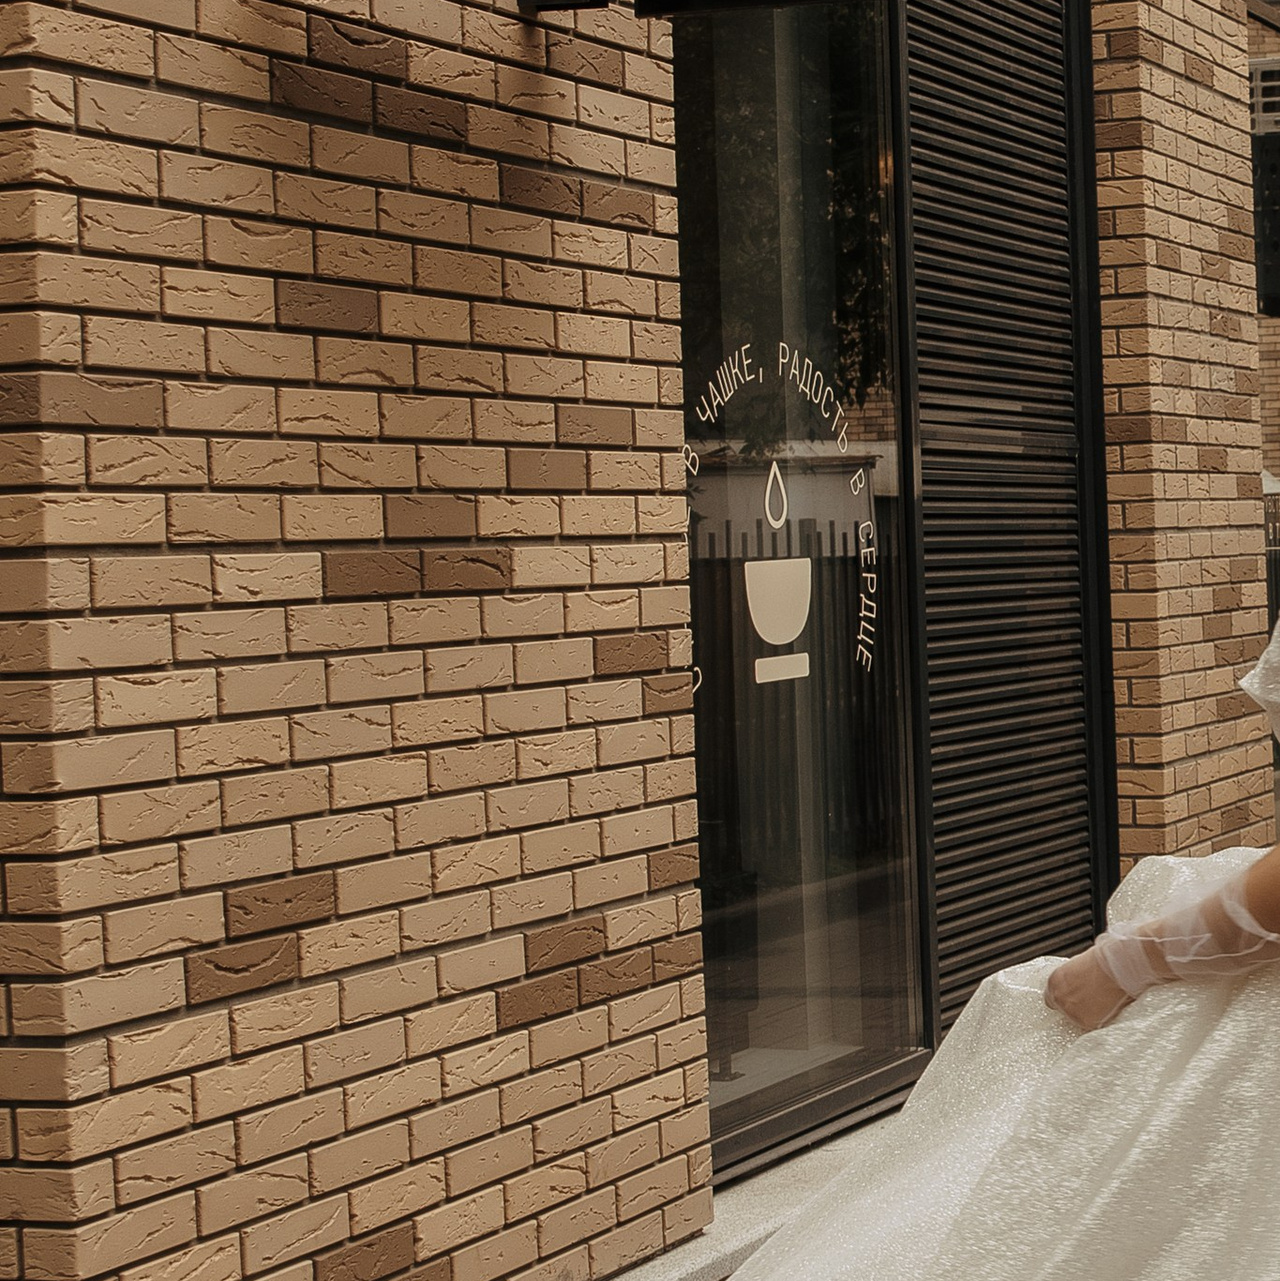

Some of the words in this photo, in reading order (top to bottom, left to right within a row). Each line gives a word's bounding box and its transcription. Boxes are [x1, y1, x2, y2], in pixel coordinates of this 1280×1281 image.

[695, 343, 764, 424] ЧАШКЕ,
[778, 341, 850, 454] РАДОСТЬ
[681, 442, 700, 476] В
[849, 468, 866, 496] В
[855, 520, 878, 673] СЕРДЦЕ
